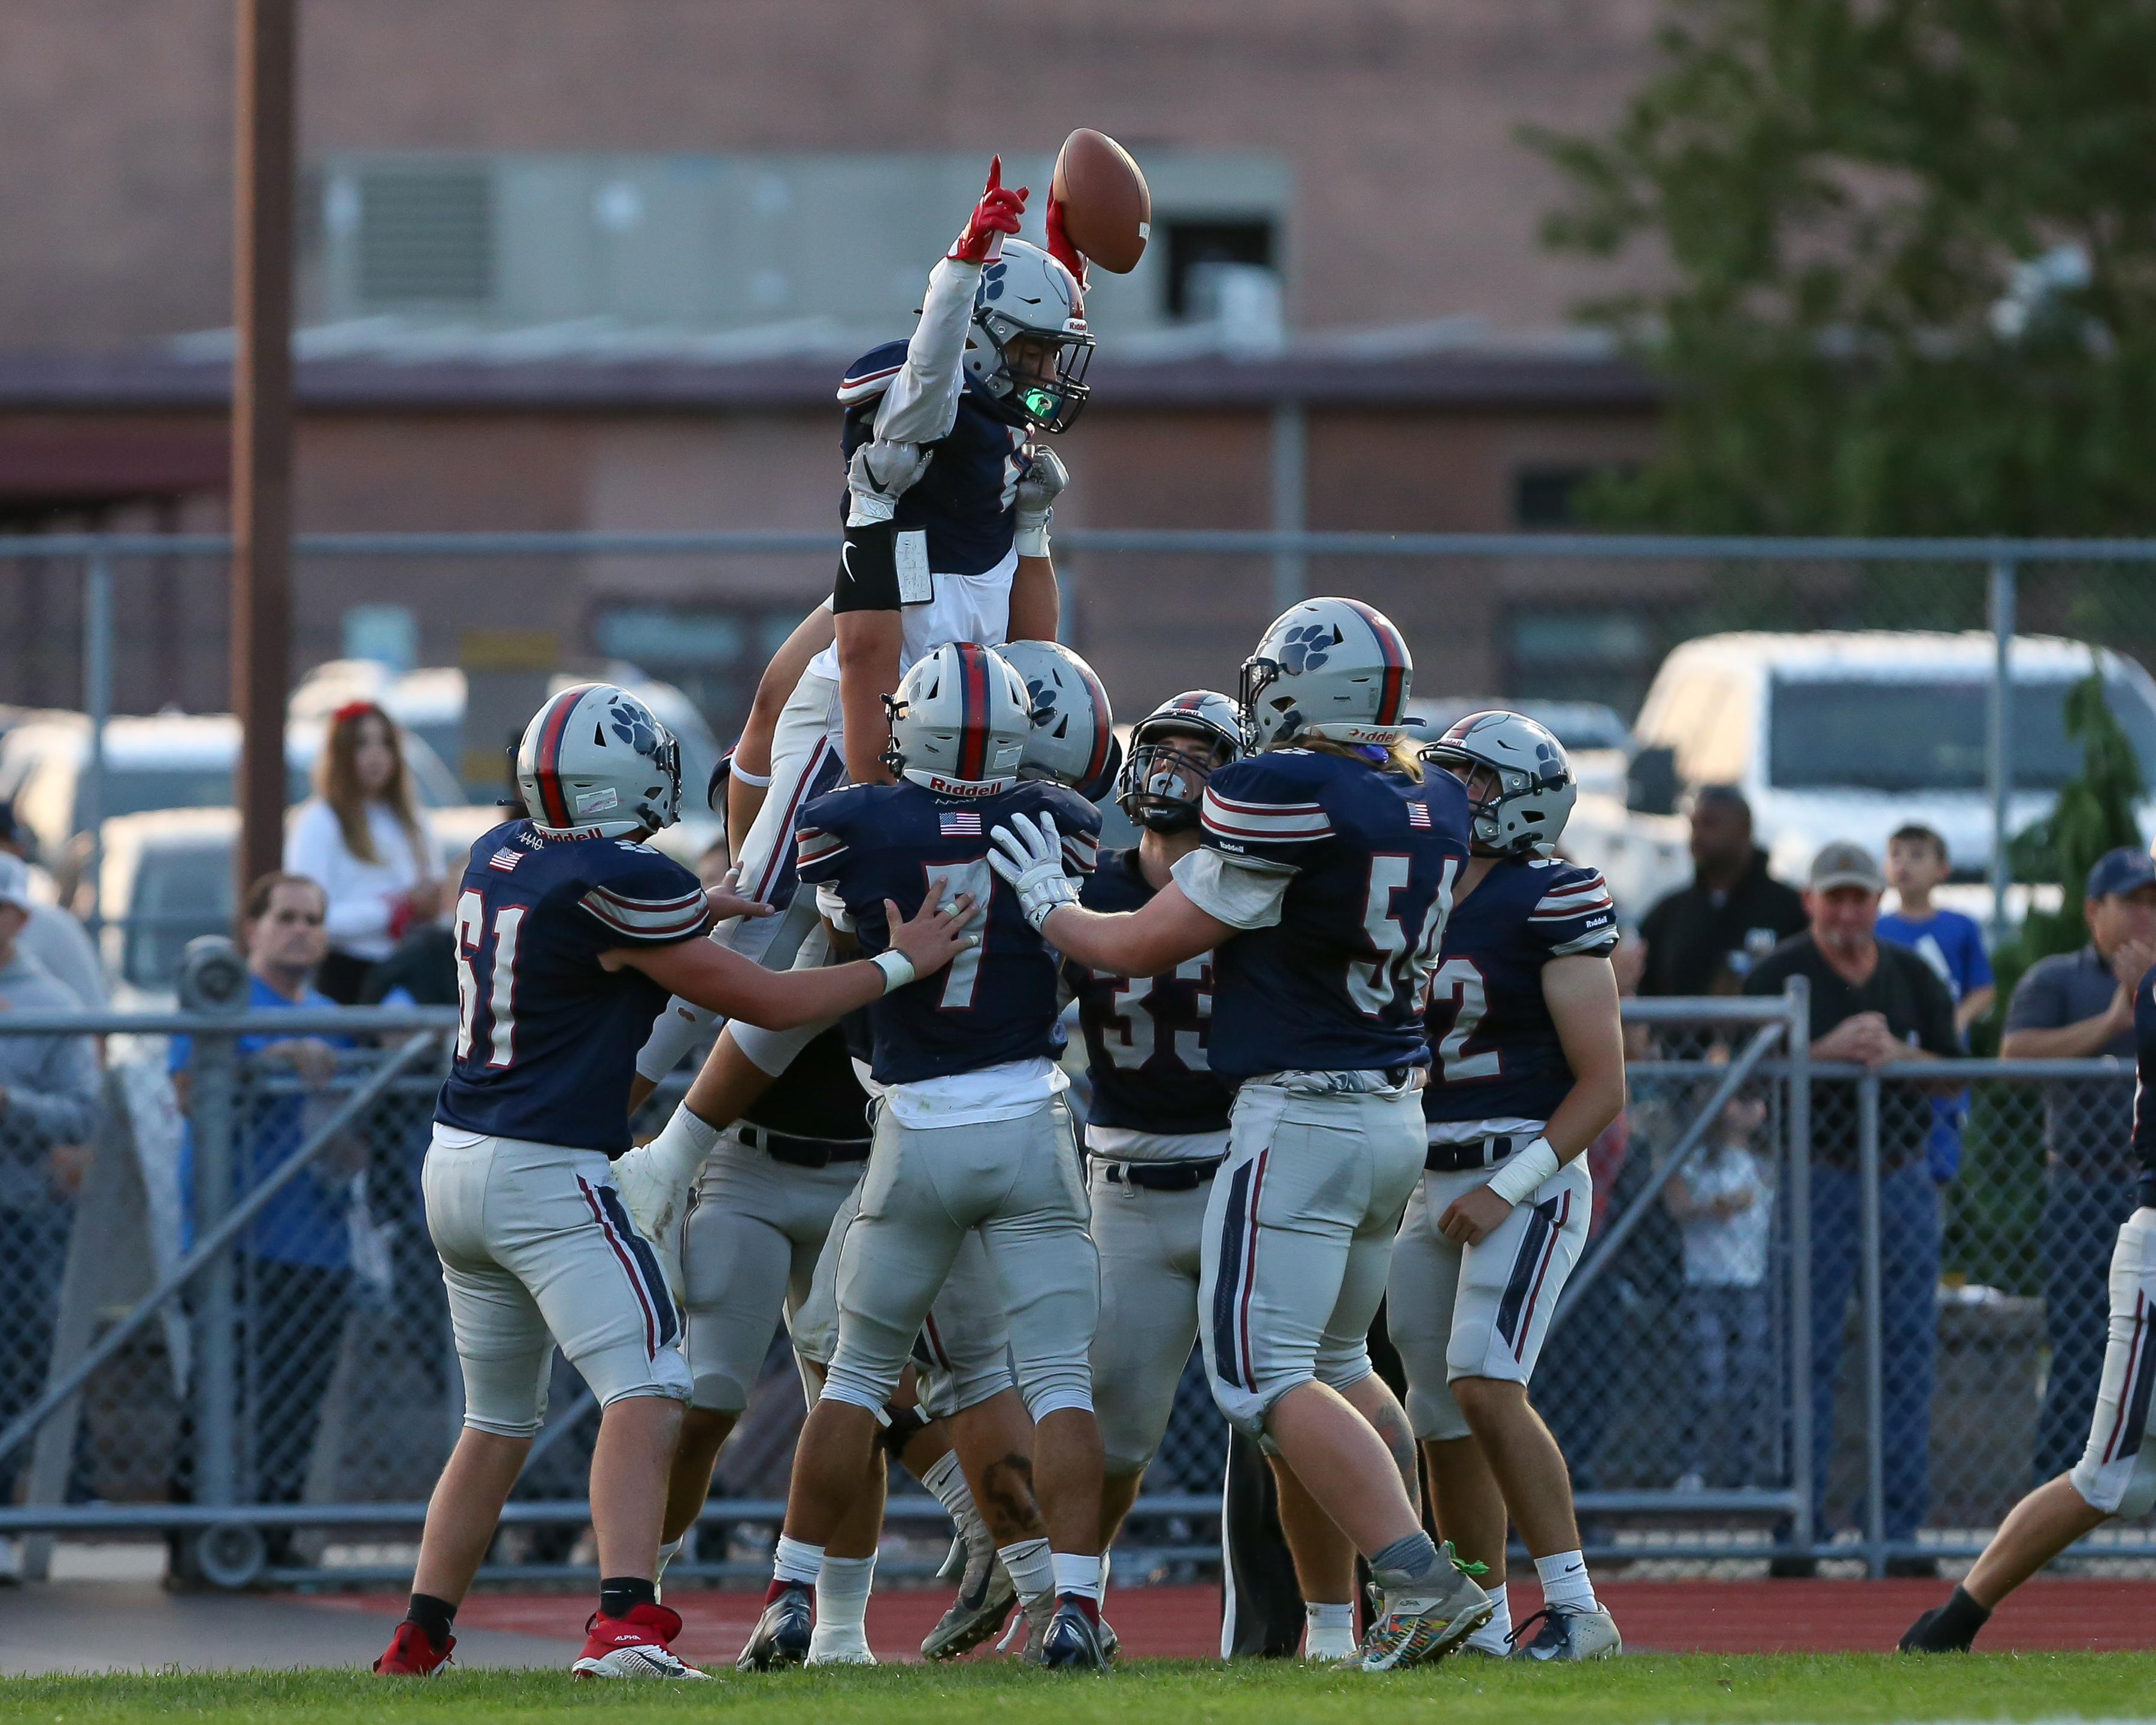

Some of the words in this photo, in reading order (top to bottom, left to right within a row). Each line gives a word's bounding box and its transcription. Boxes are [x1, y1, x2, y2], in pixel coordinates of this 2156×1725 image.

[929, 777, 1001, 796] Riddell
[1220, 841, 1244, 853] Riddell
[1586, 916, 1607, 928] Riddell
[920, 855, 995, 1011] 7
[453, 887, 529, 1069] 61
